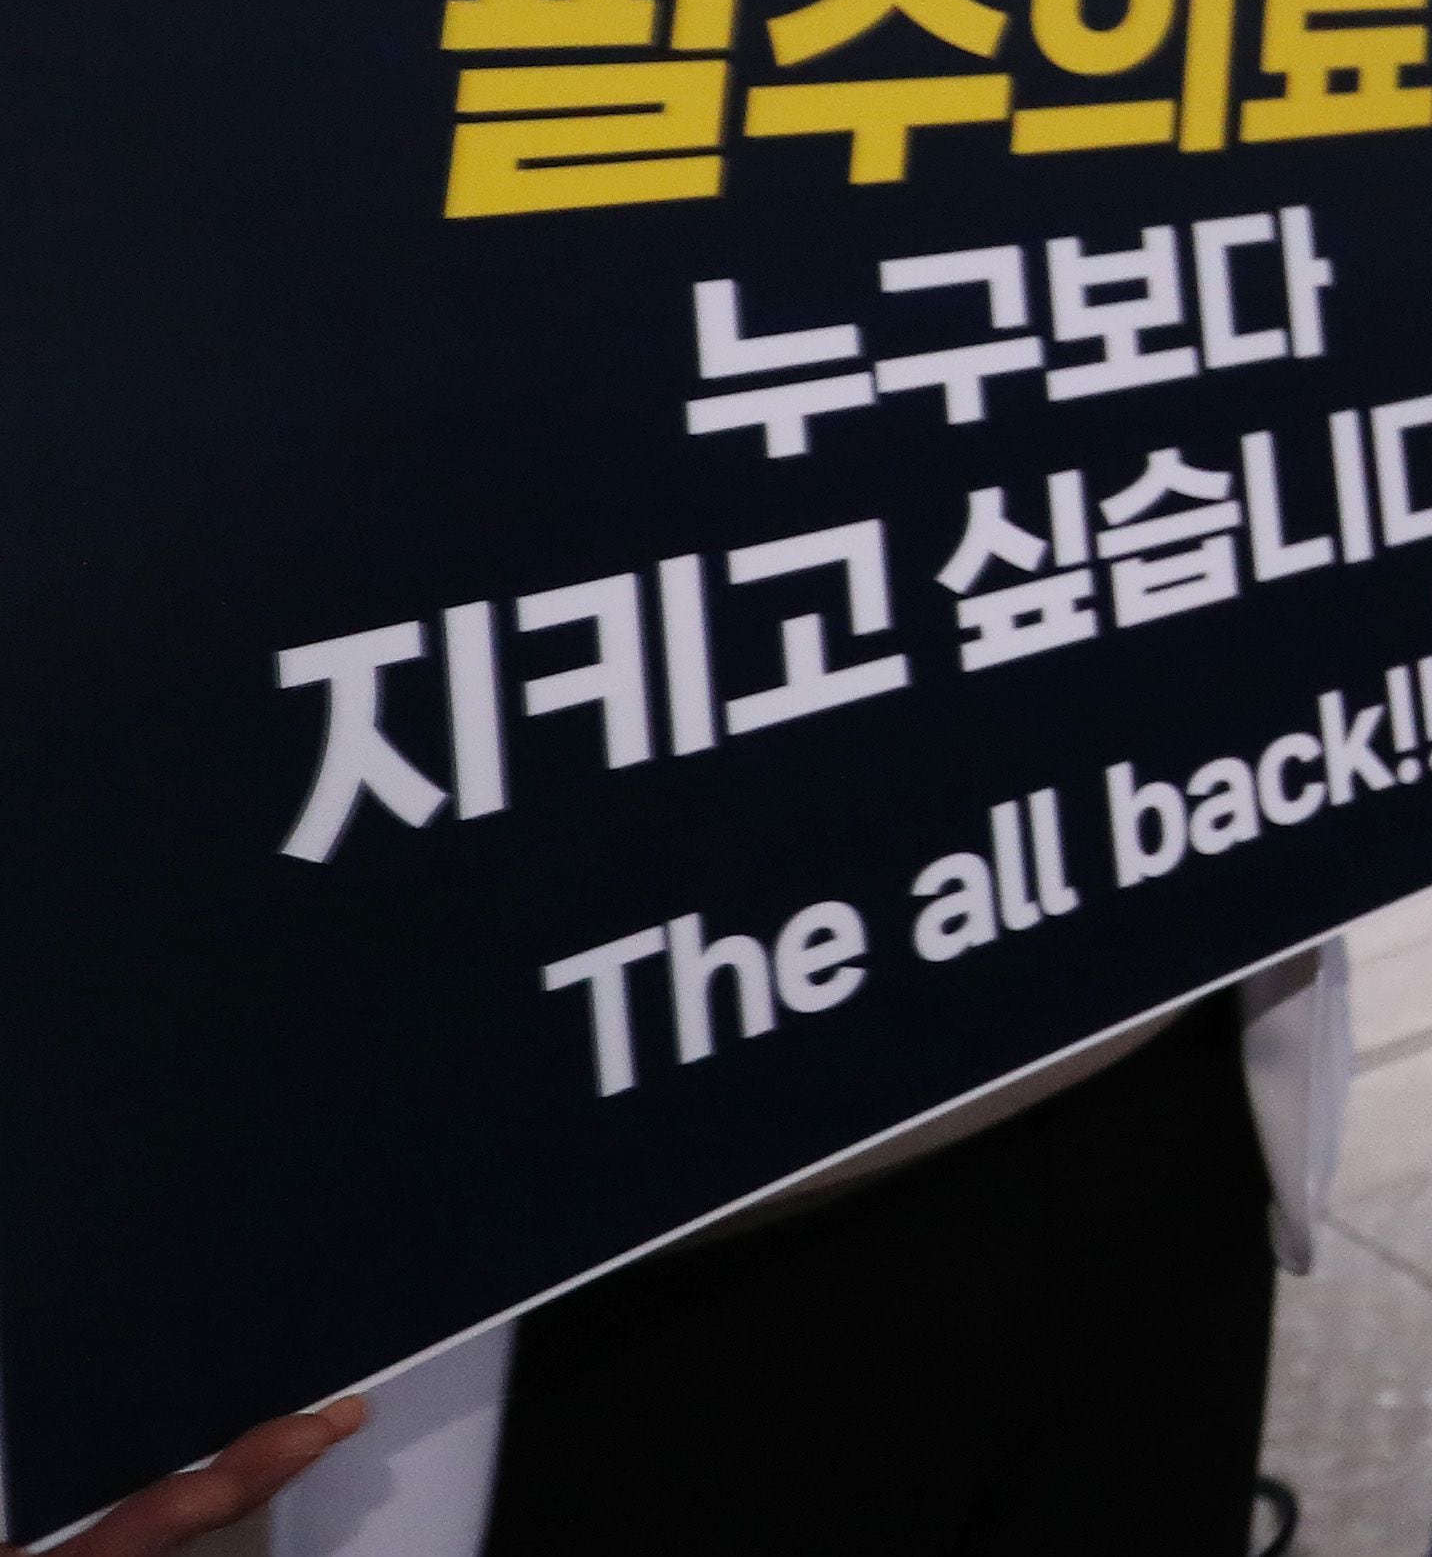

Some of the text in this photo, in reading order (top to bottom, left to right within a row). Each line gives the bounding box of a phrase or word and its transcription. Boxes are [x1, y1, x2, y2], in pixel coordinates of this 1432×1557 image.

[686, 205, 1334, 458] 누구보다
[277, 518, 910, 864] 지키고
[543, 900, 866, 1097] The
[911, 788, 1079, 962] all
